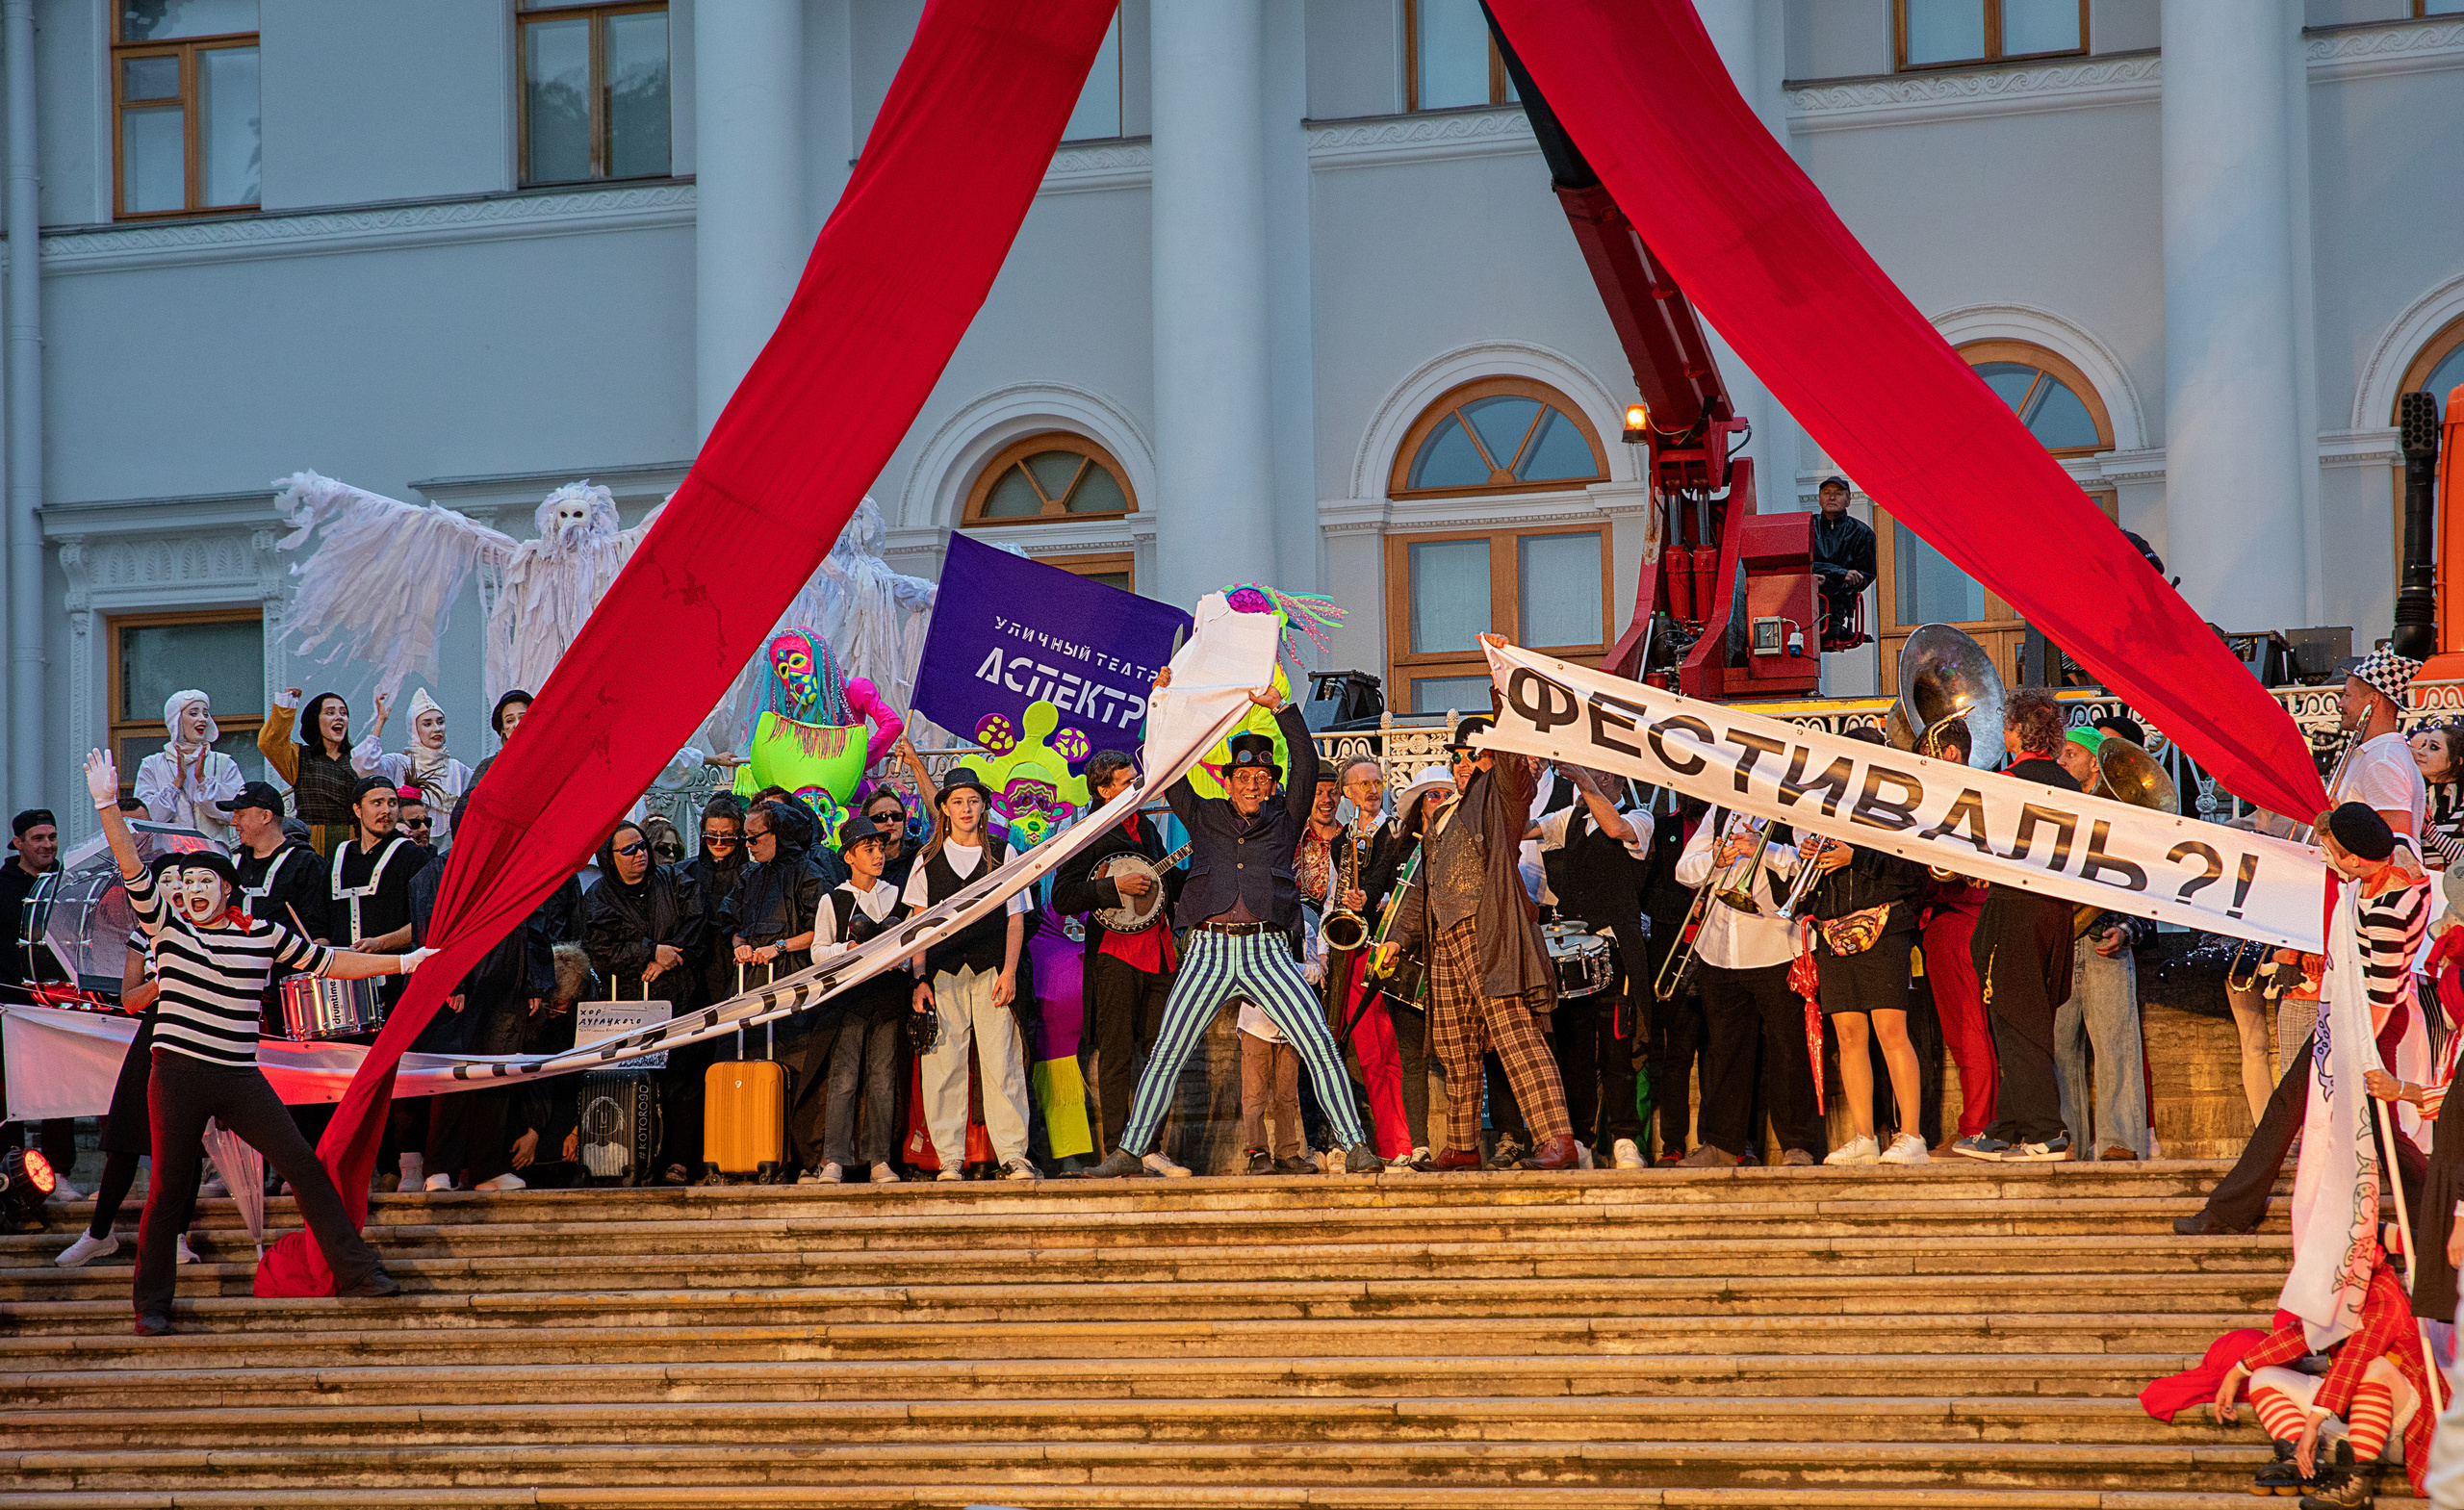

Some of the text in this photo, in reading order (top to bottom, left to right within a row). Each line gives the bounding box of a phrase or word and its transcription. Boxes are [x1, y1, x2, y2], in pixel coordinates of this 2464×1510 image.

[994, 615, 1159, 682] УЛИЧНЫЙ ТЕАТР
[975, 646, 1147, 729] АСПЕКТР
[330, 981, 341, 1024] drumtime
